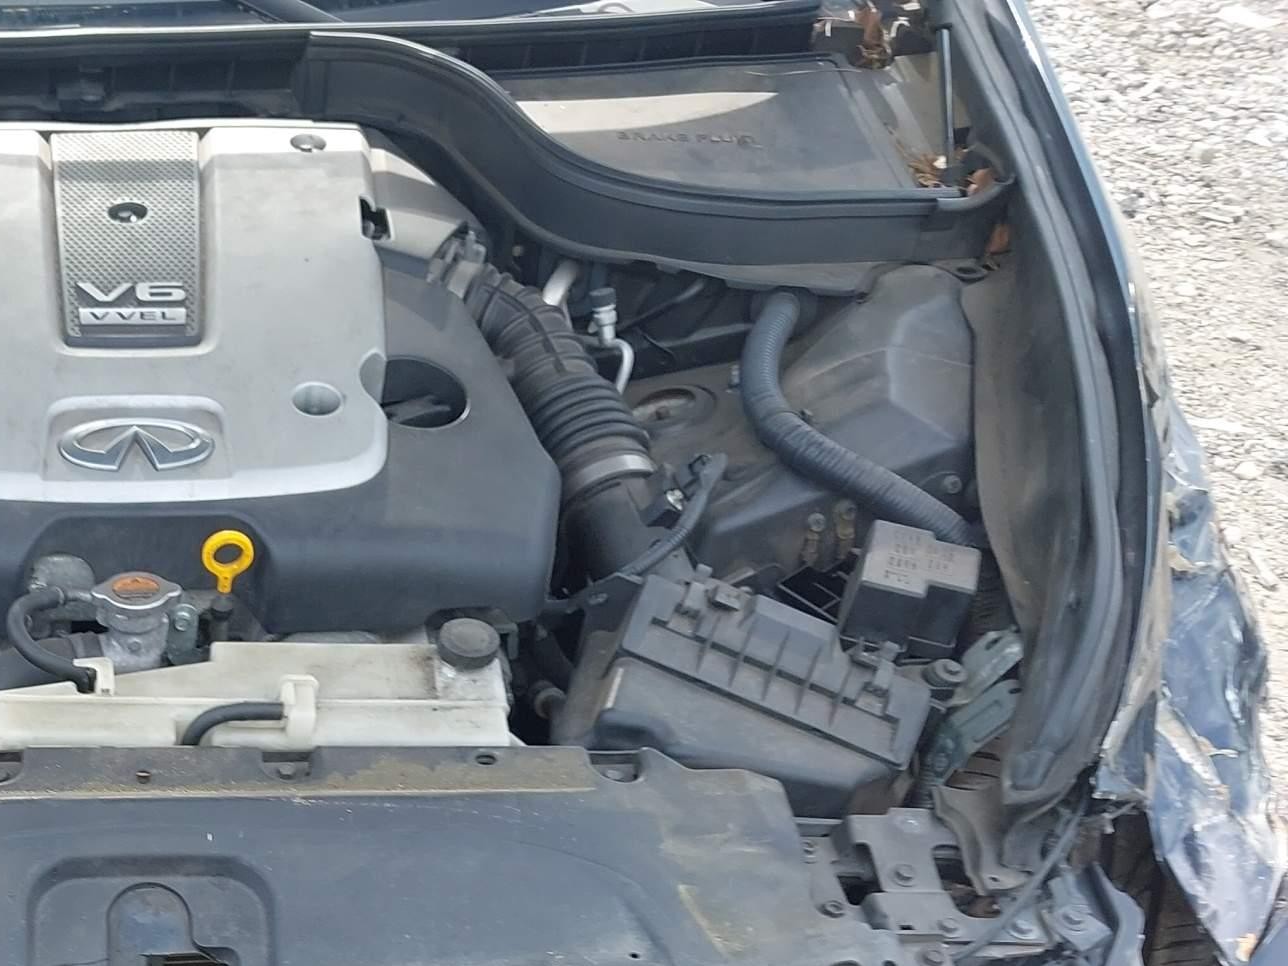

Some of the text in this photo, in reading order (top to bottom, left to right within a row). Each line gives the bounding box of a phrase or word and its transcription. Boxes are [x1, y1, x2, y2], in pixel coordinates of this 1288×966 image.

[616, 131, 689, 143] BRAKE
[75, 282, 187, 302] V6
[89, 311, 176, 321] VVEL
